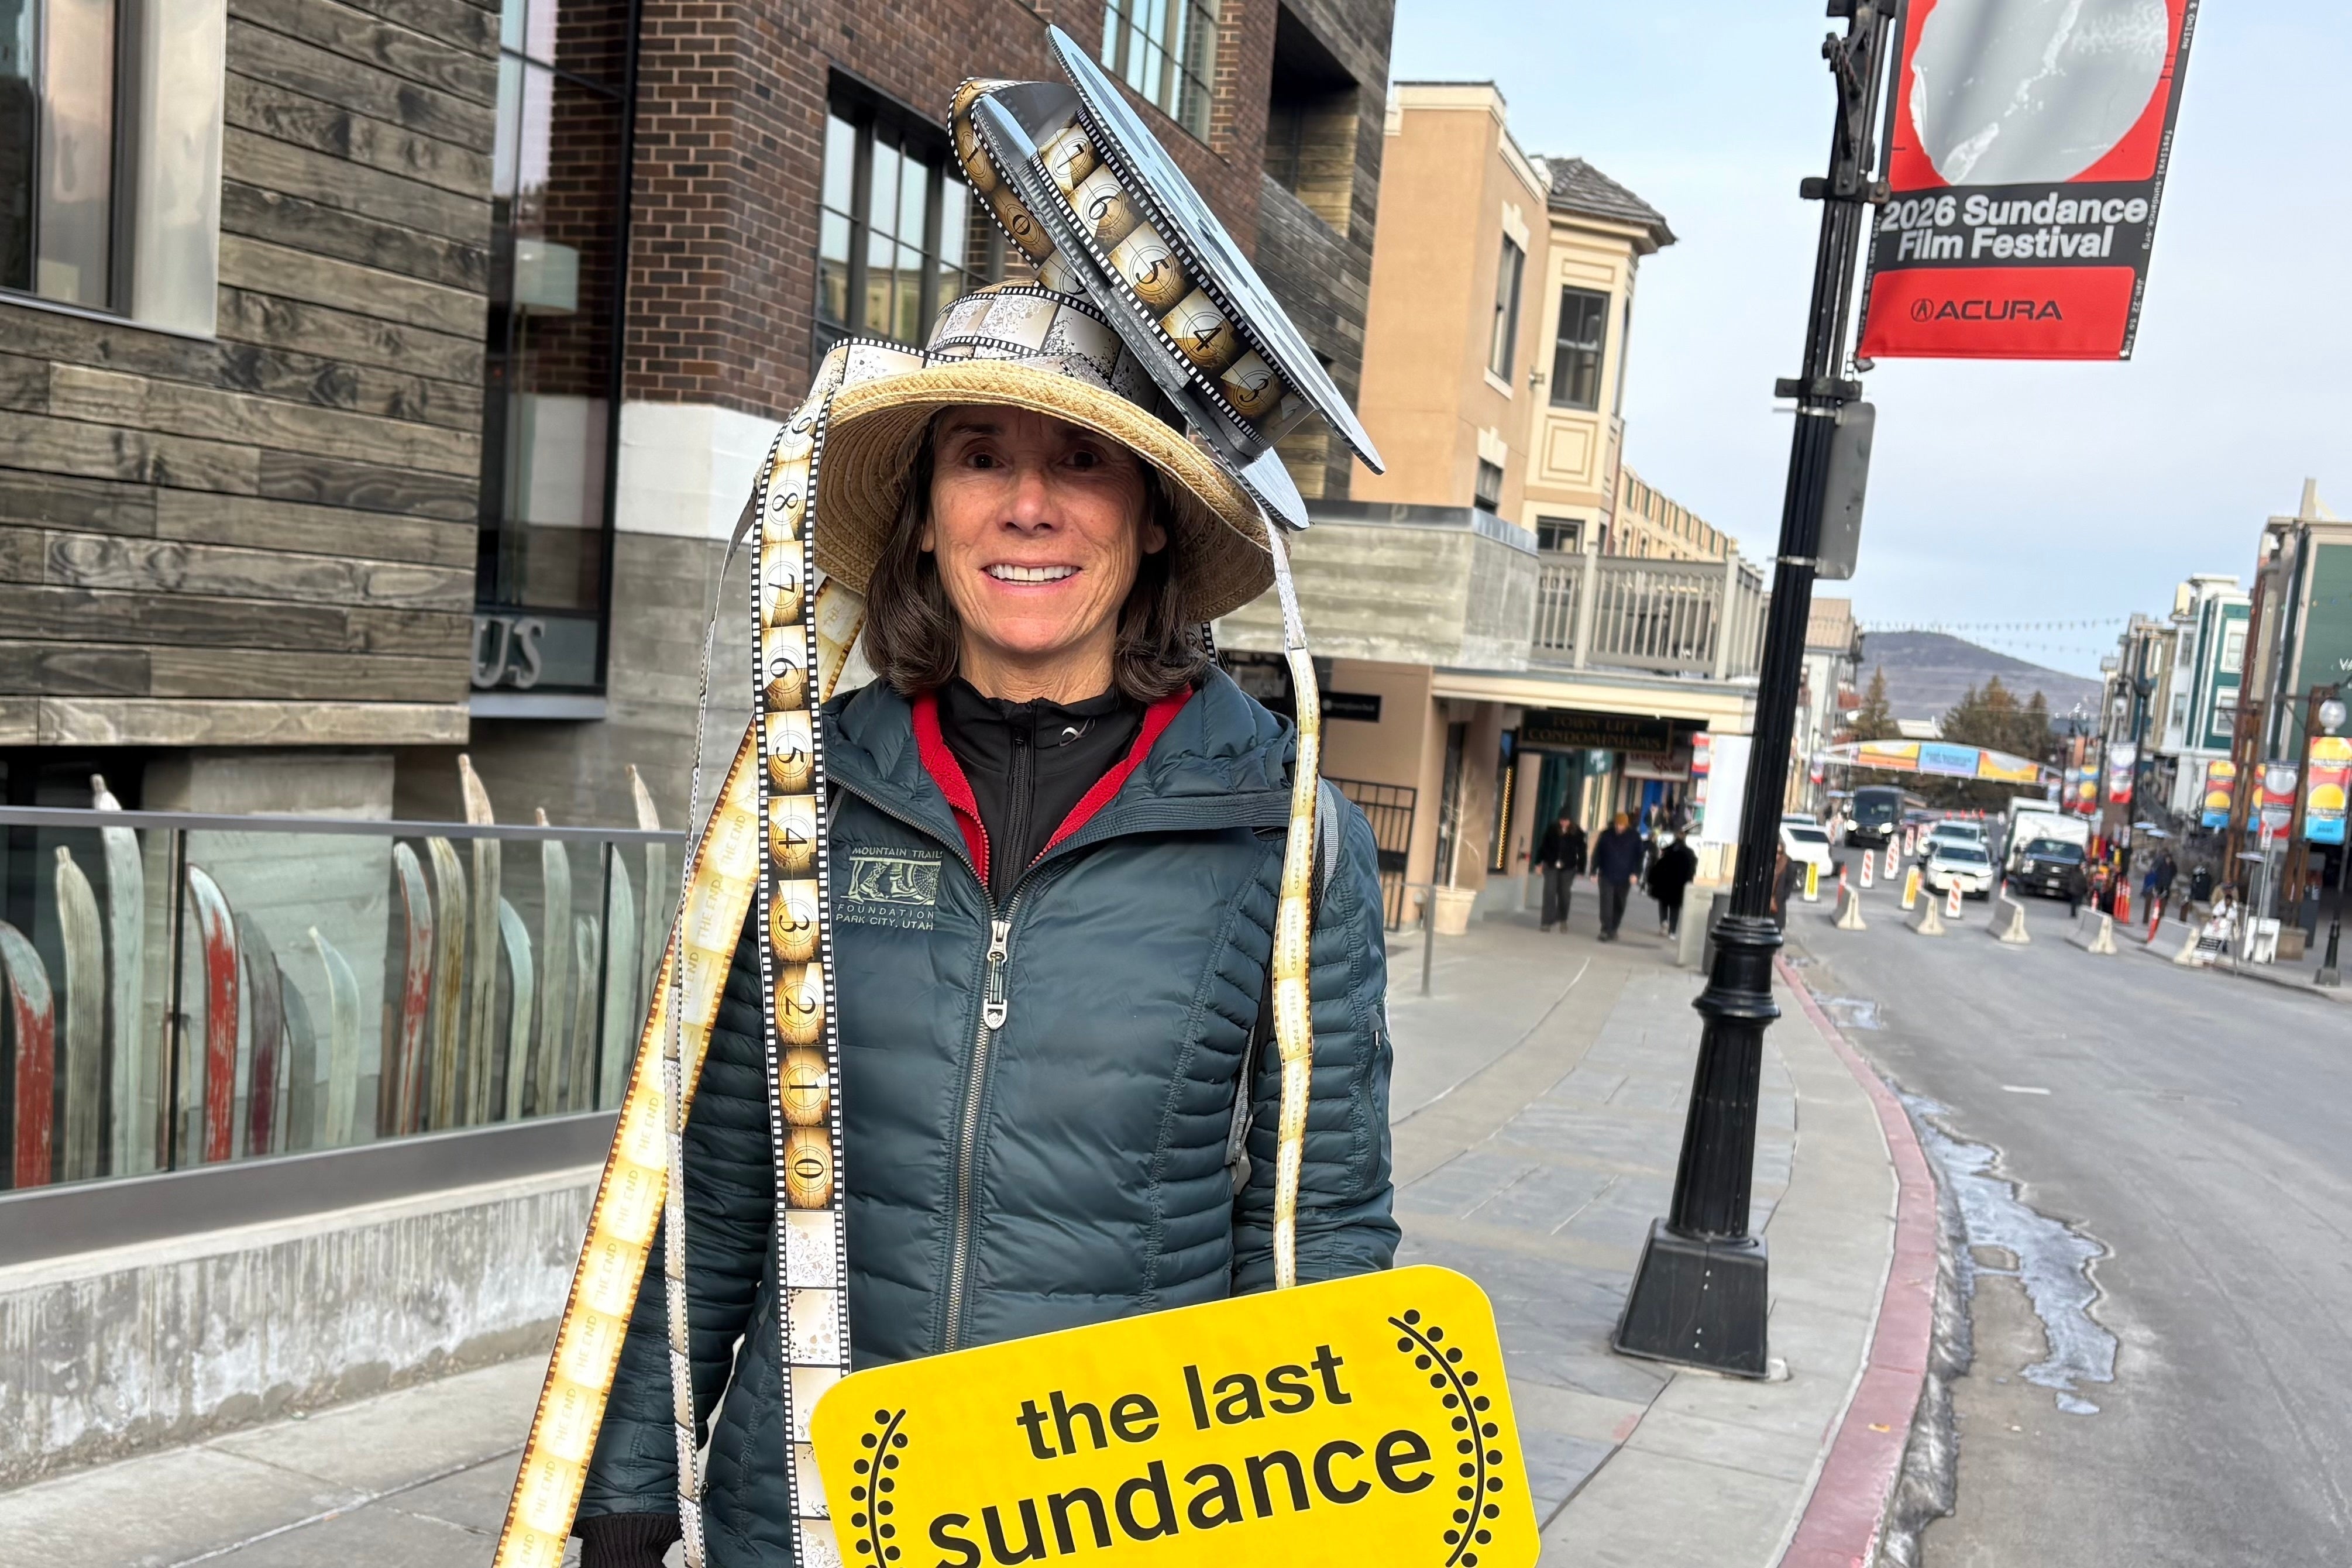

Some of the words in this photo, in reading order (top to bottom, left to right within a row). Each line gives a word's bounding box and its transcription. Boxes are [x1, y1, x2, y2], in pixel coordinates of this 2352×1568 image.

[1880, 195, 1957, 232] 2026
[1962, 192, 2149, 226] Sundance
[1896, 228, 1964, 262] Film
[1971, 226, 2114, 259] Festival
[1934, 300, 2063, 321] ACURA
[731, 814, 746, 839] END
[852, 847, 907, 856] MOUNTAIN
[697, 913, 711, 939] THE
[707, 879, 722, 911] END
[835, 913, 865, 924] PARK
[870, 917, 898, 929] CITY,
[902, 920, 934, 931] UTAH
[837, 904, 934, 919] FOUNDATION
[685, 951, 699, 982] END
[643, 1097, 659, 1127] END
[615, 1205, 631, 1230] THE
[624, 1169, 639, 1202] END
[603, 1242, 617, 1275] END
[583, 1315, 597, 1347] END
[561, 1388, 576, 1420] END
[1016, 1390, 1159, 1459] the
[1183, 1345, 1352, 1430] last
[541, 1460, 556, 1492] END
[929, 1429, 1435, 1568] sundance
[520, 1533, 535, 1565] END
